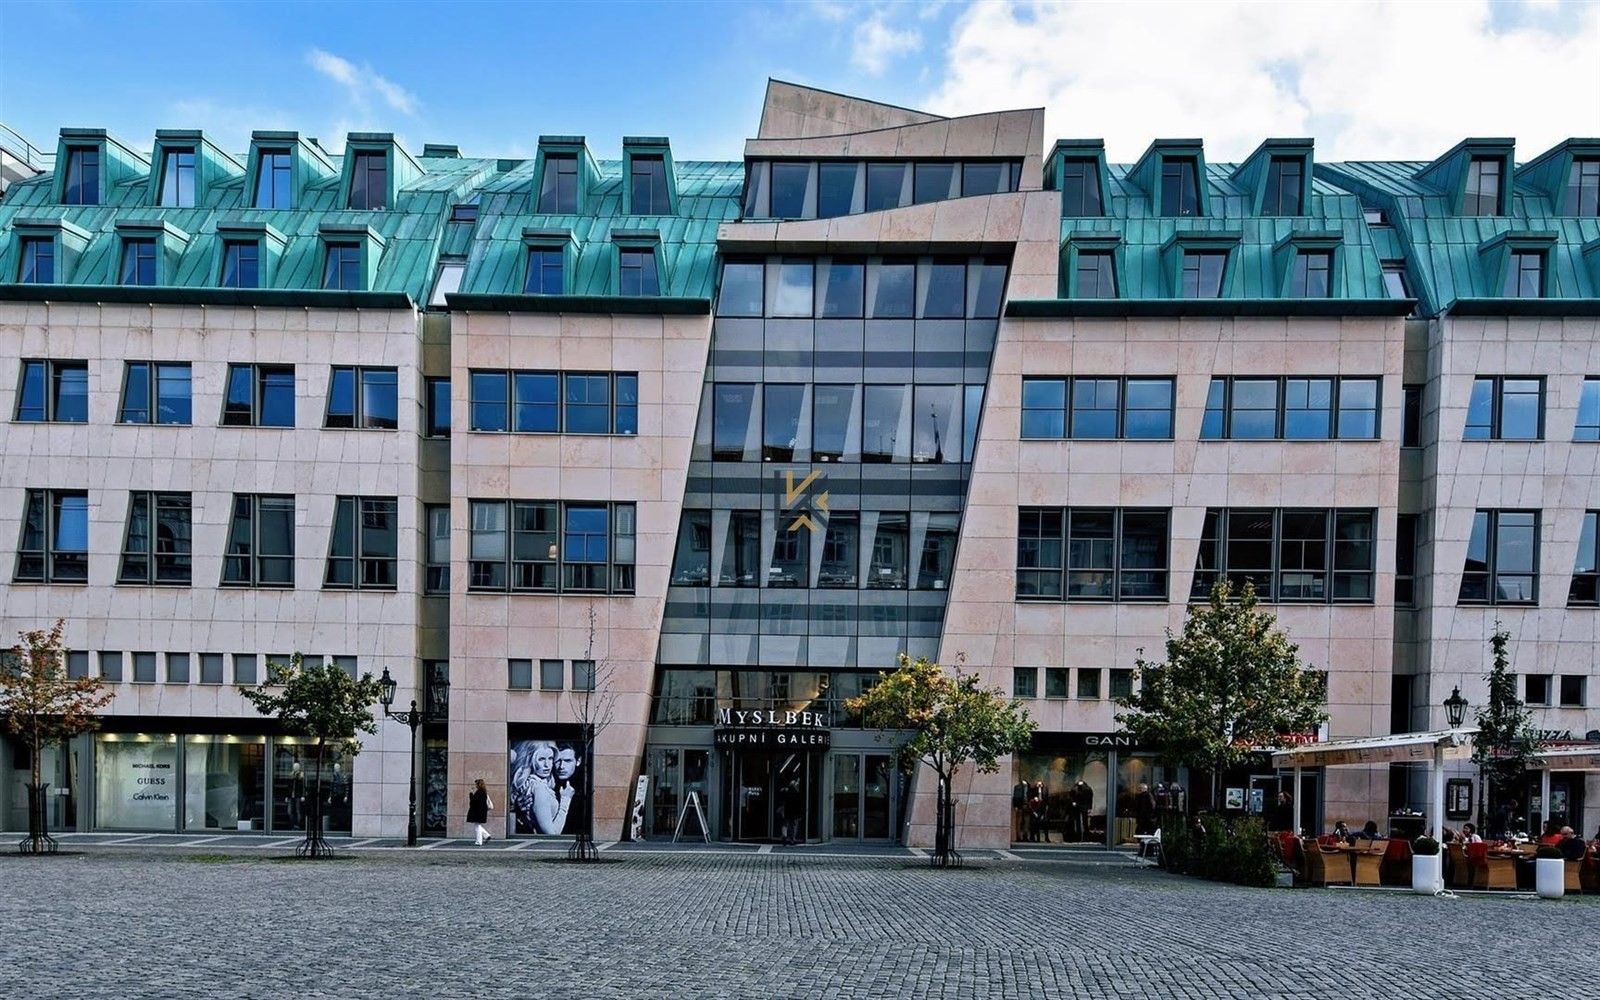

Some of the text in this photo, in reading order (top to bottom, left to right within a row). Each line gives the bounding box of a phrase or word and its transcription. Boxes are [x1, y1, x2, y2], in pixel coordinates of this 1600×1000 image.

[719, 708, 823, 726] MYSLBEK
[132, 793, 169, 801] Calvin Klein
